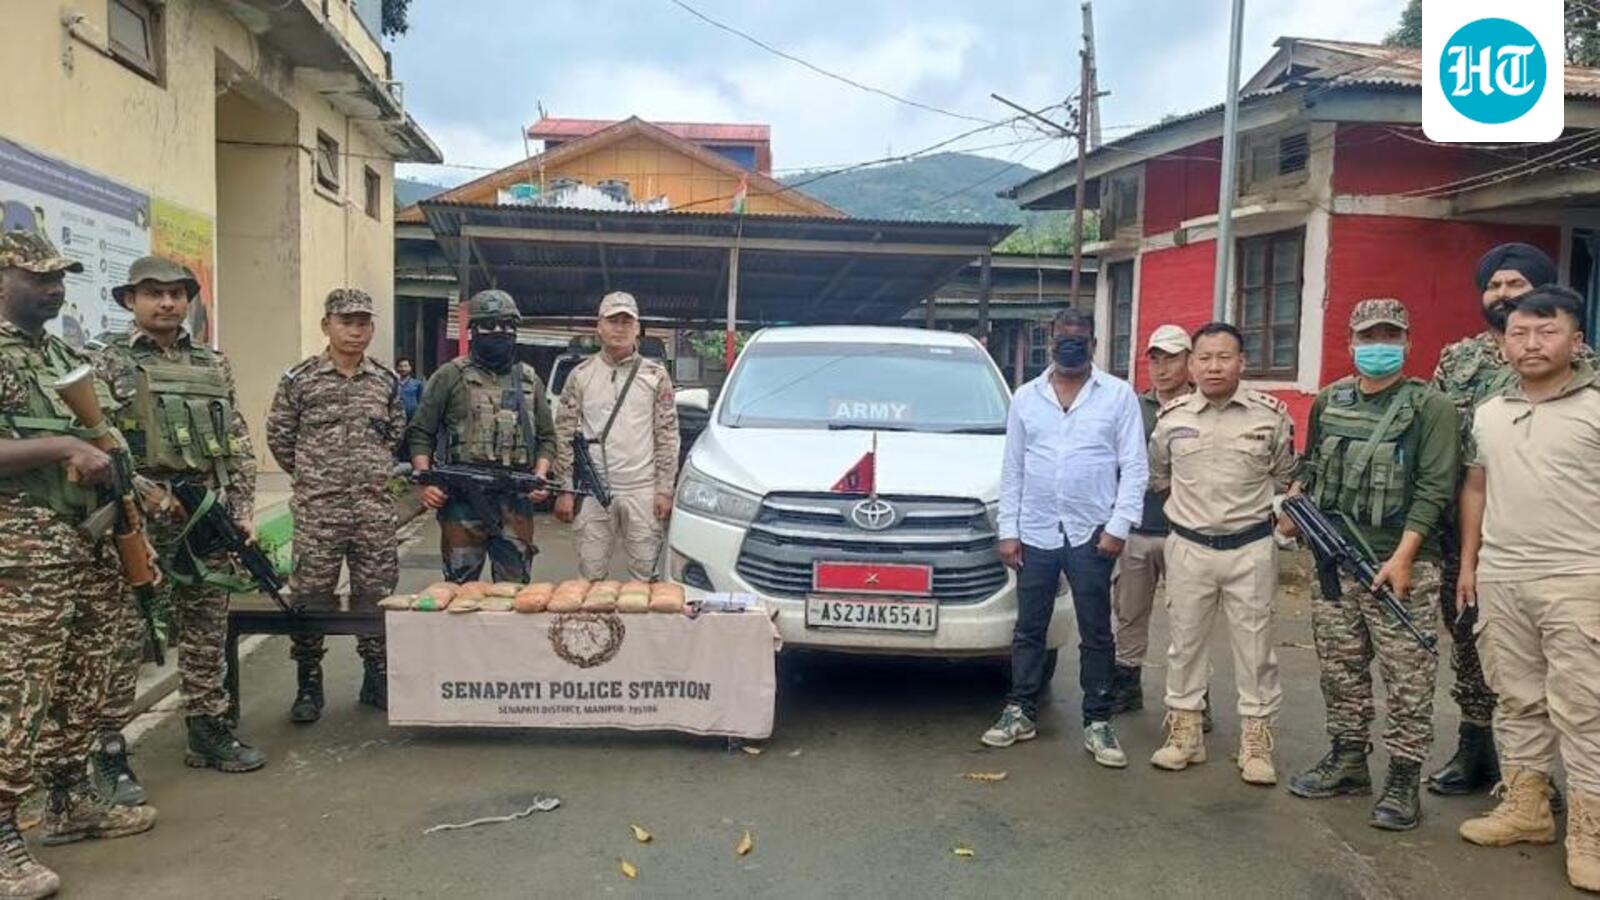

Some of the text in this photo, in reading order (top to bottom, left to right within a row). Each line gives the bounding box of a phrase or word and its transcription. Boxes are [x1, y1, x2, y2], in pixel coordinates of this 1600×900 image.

[834, 402, 907, 420] ARMY
[821, 603, 933, 626] AS23AK5541
[441, 681, 711, 701] SENAPATI POLICE STATION
[498, 705, 539, 714] SENAPATI
